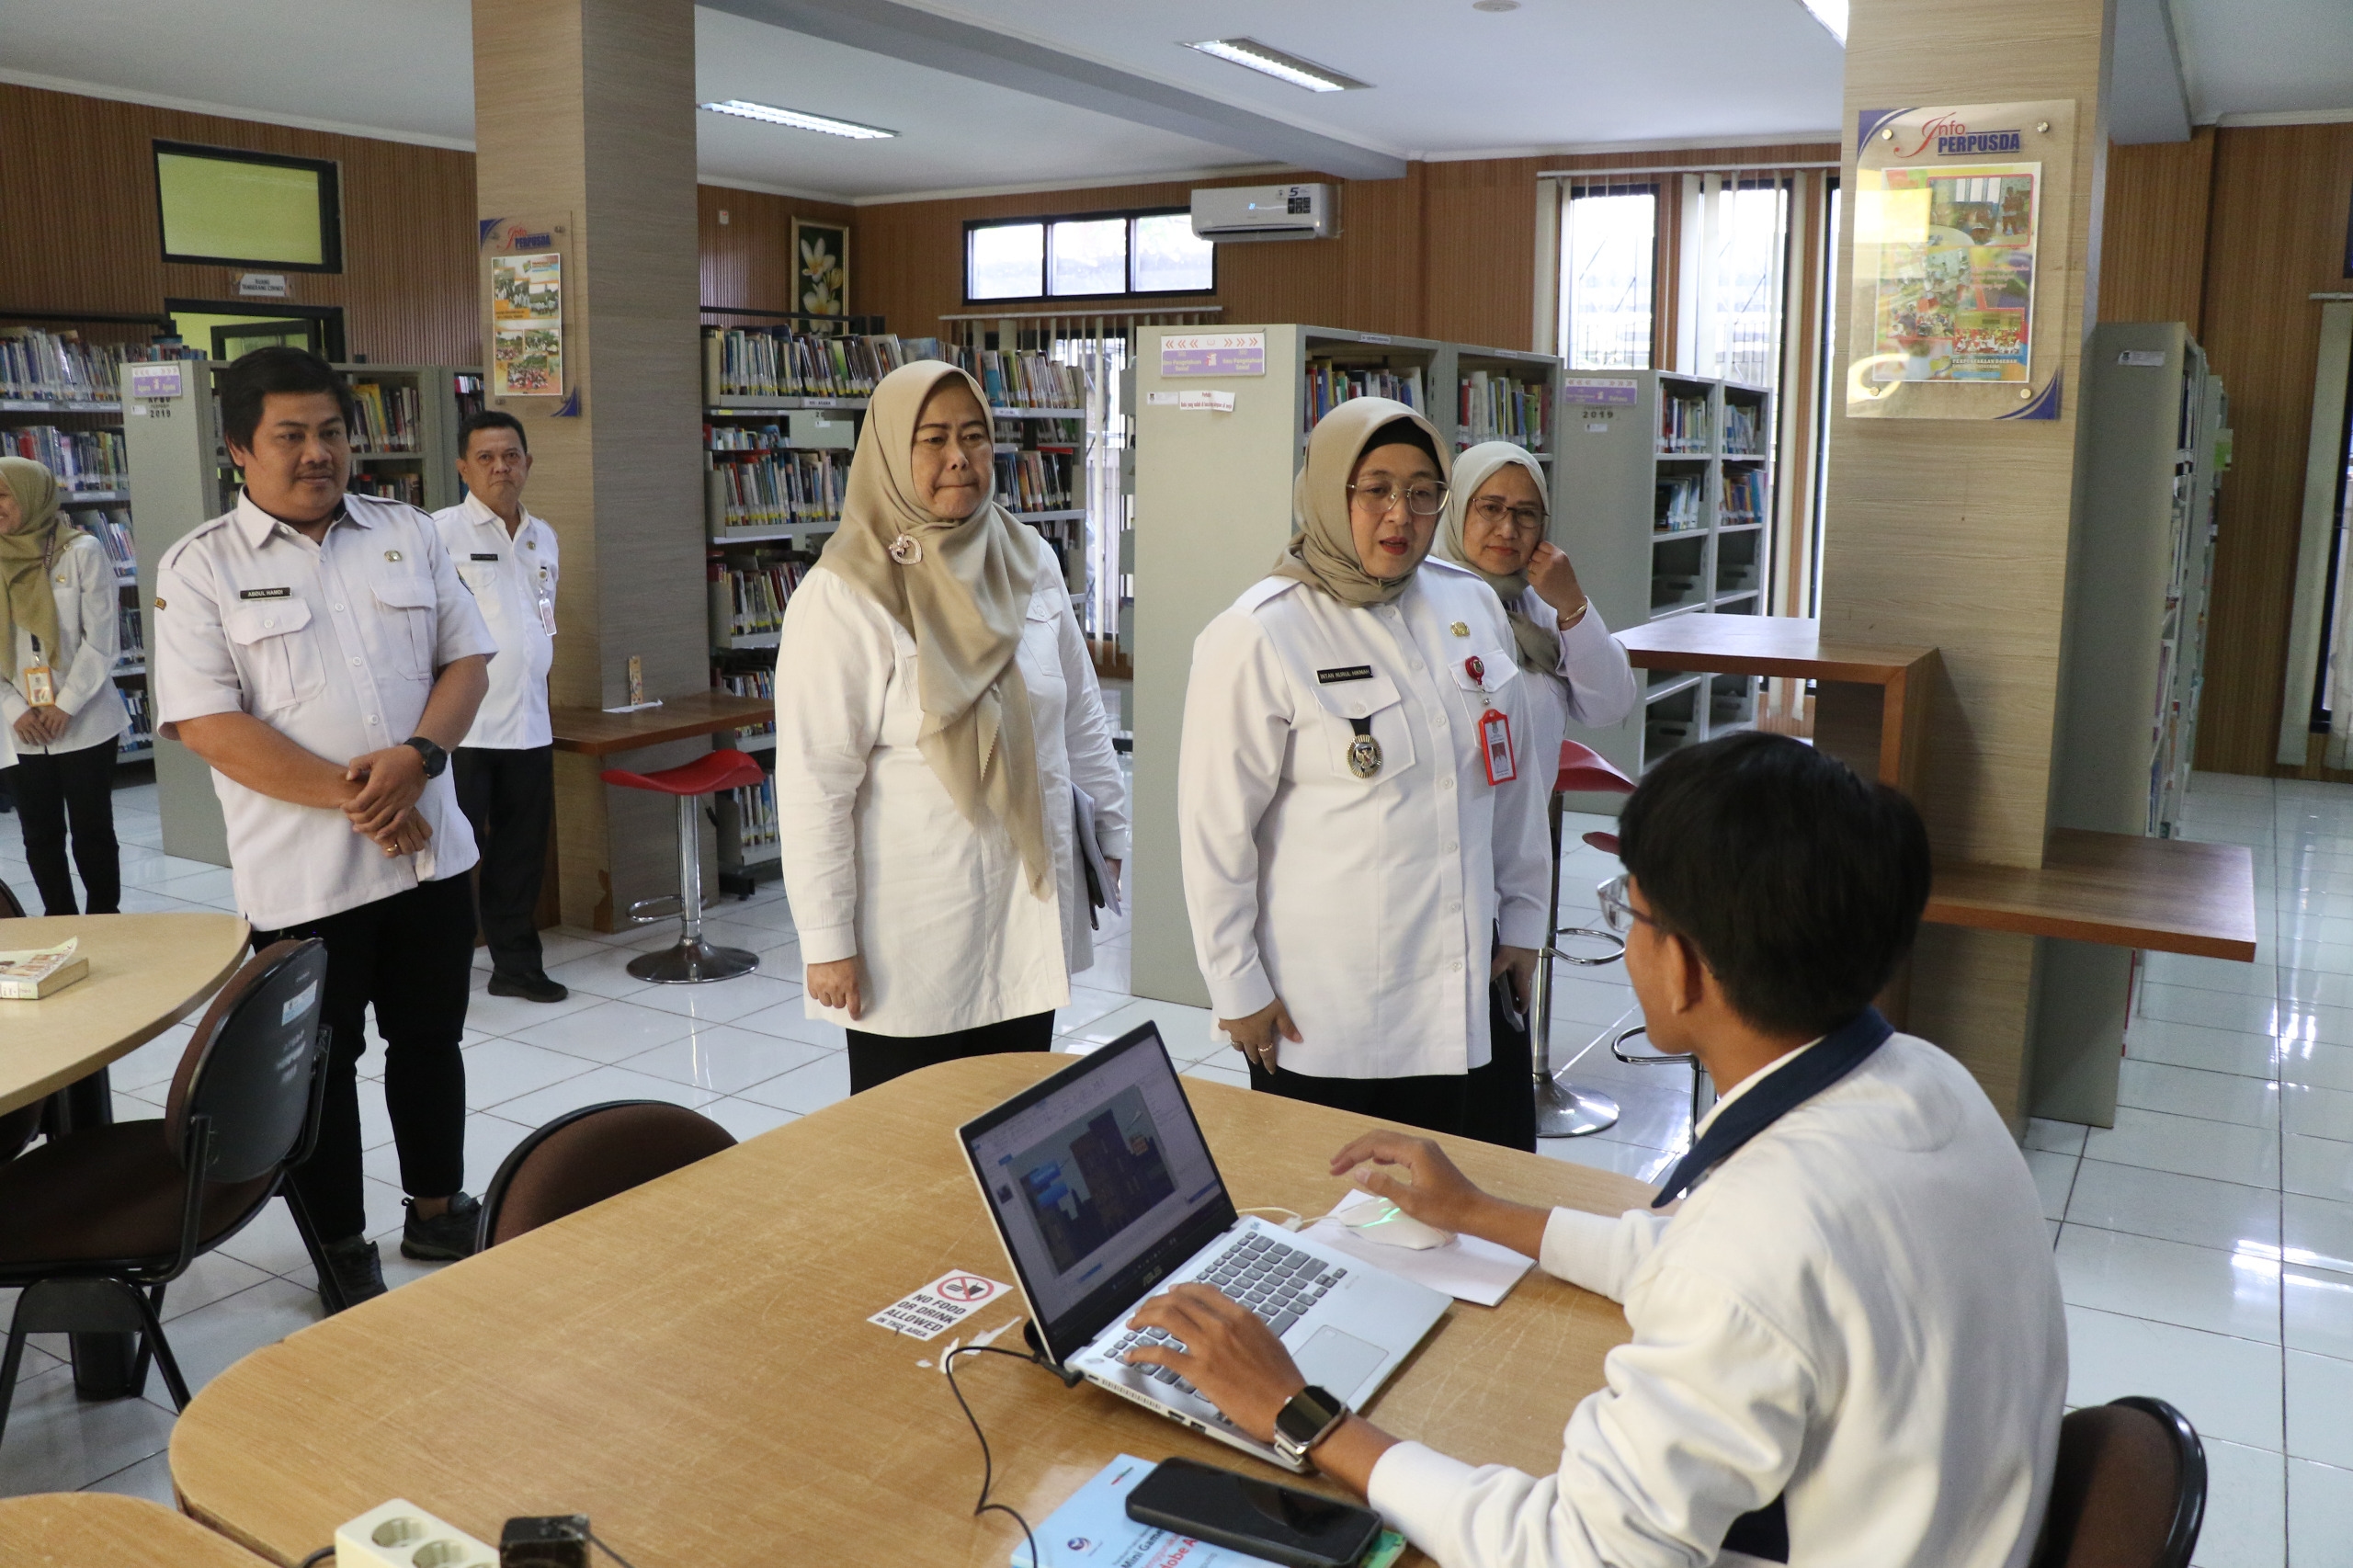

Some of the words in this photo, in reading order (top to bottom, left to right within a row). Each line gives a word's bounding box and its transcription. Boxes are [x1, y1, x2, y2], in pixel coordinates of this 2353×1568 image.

[1893, 111, 1966, 159] Info
[1938, 132, 2020, 153] PERPUSDA
[1289, 187, 1300, 197] 5
[150, 409, 171, 418] 2019
[1319, 672, 1335, 680] INTAN
[1142, 1265, 1163, 1287] ASUS
[897, 1301, 915, 1311] OR
[915, 1305, 958, 1324] DRINK
[913, 1293, 933, 1303] NO
[932, 1300, 967, 1315] FOOD
[883, 1309, 944, 1332] ALLOWED
[906, 1326, 928, 1338] AREA
[1120, 1551, 1144, 1568] Mini
